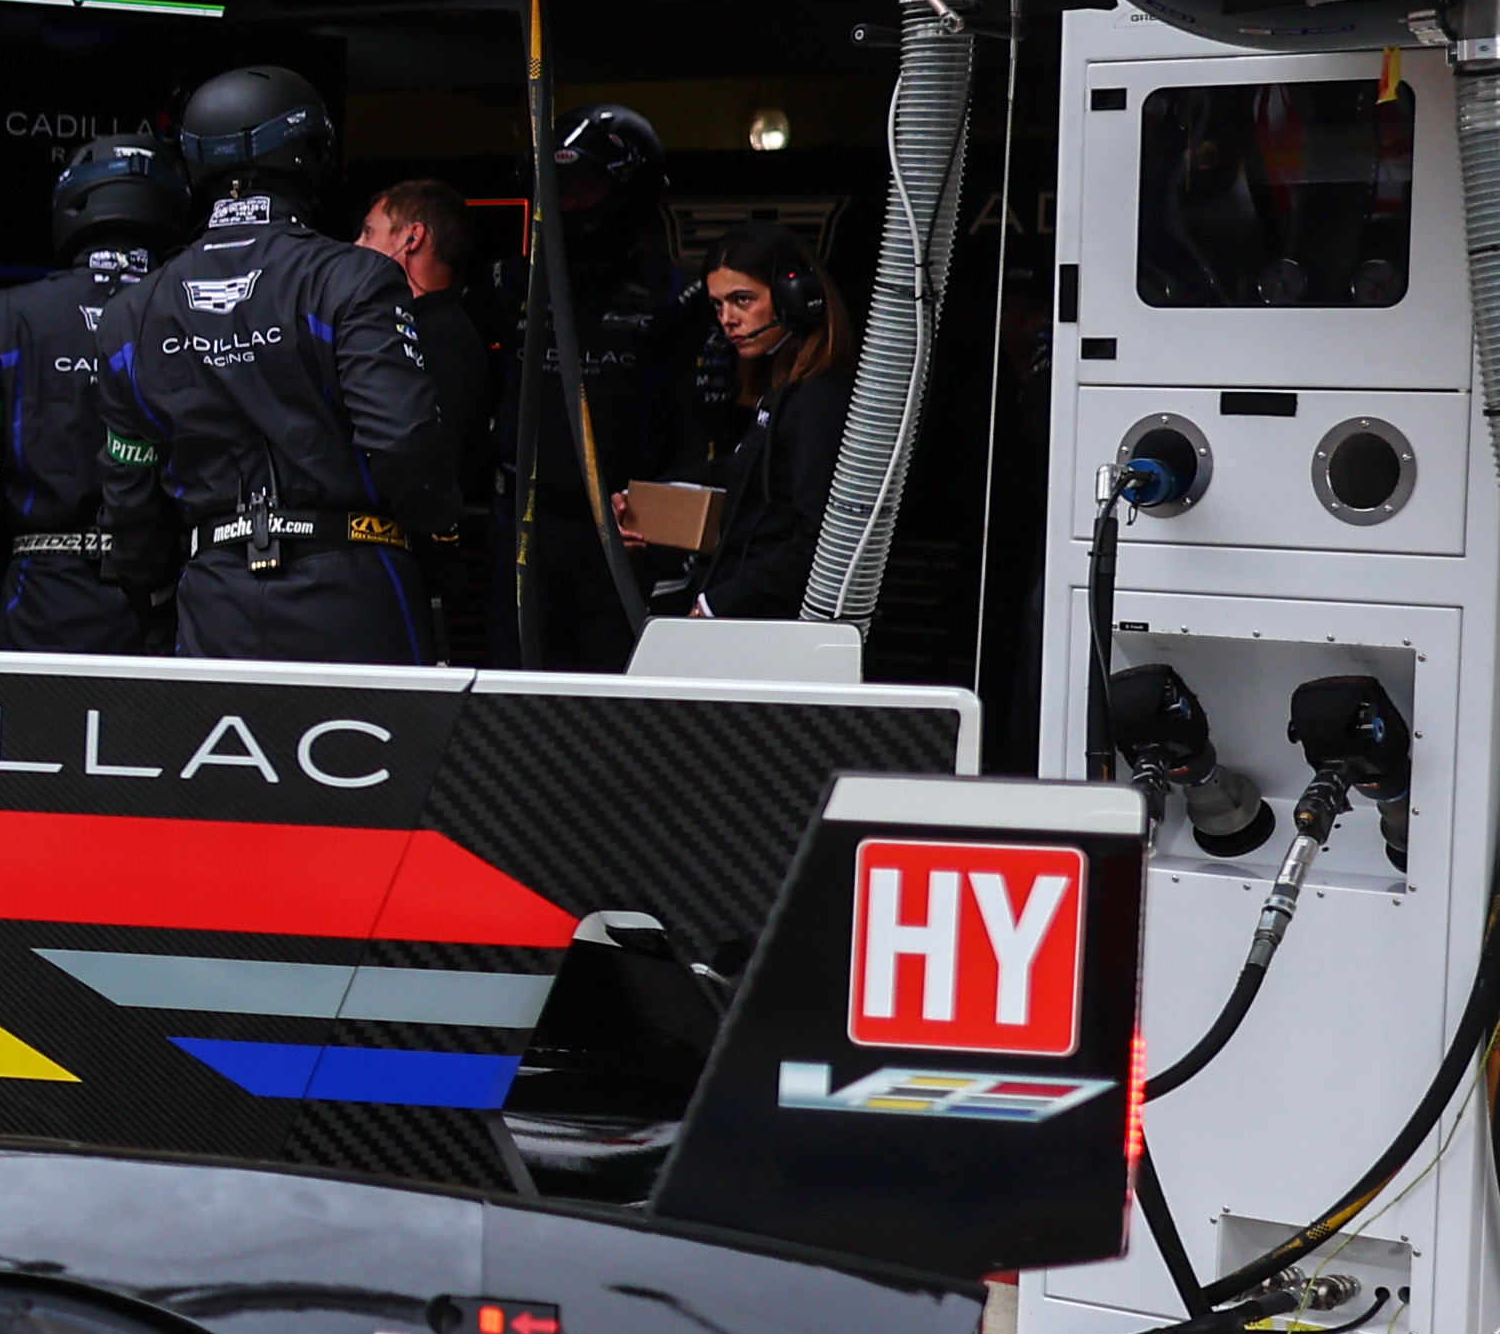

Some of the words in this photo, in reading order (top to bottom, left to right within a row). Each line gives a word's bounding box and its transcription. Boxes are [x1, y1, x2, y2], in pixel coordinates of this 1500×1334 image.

[163, 327, 282, 356] CADILLAC
[203, 350, 255, 367] ACING
[213, 514, 314, 545] mechix.com
[862, 867, 1069, 1026] HY
